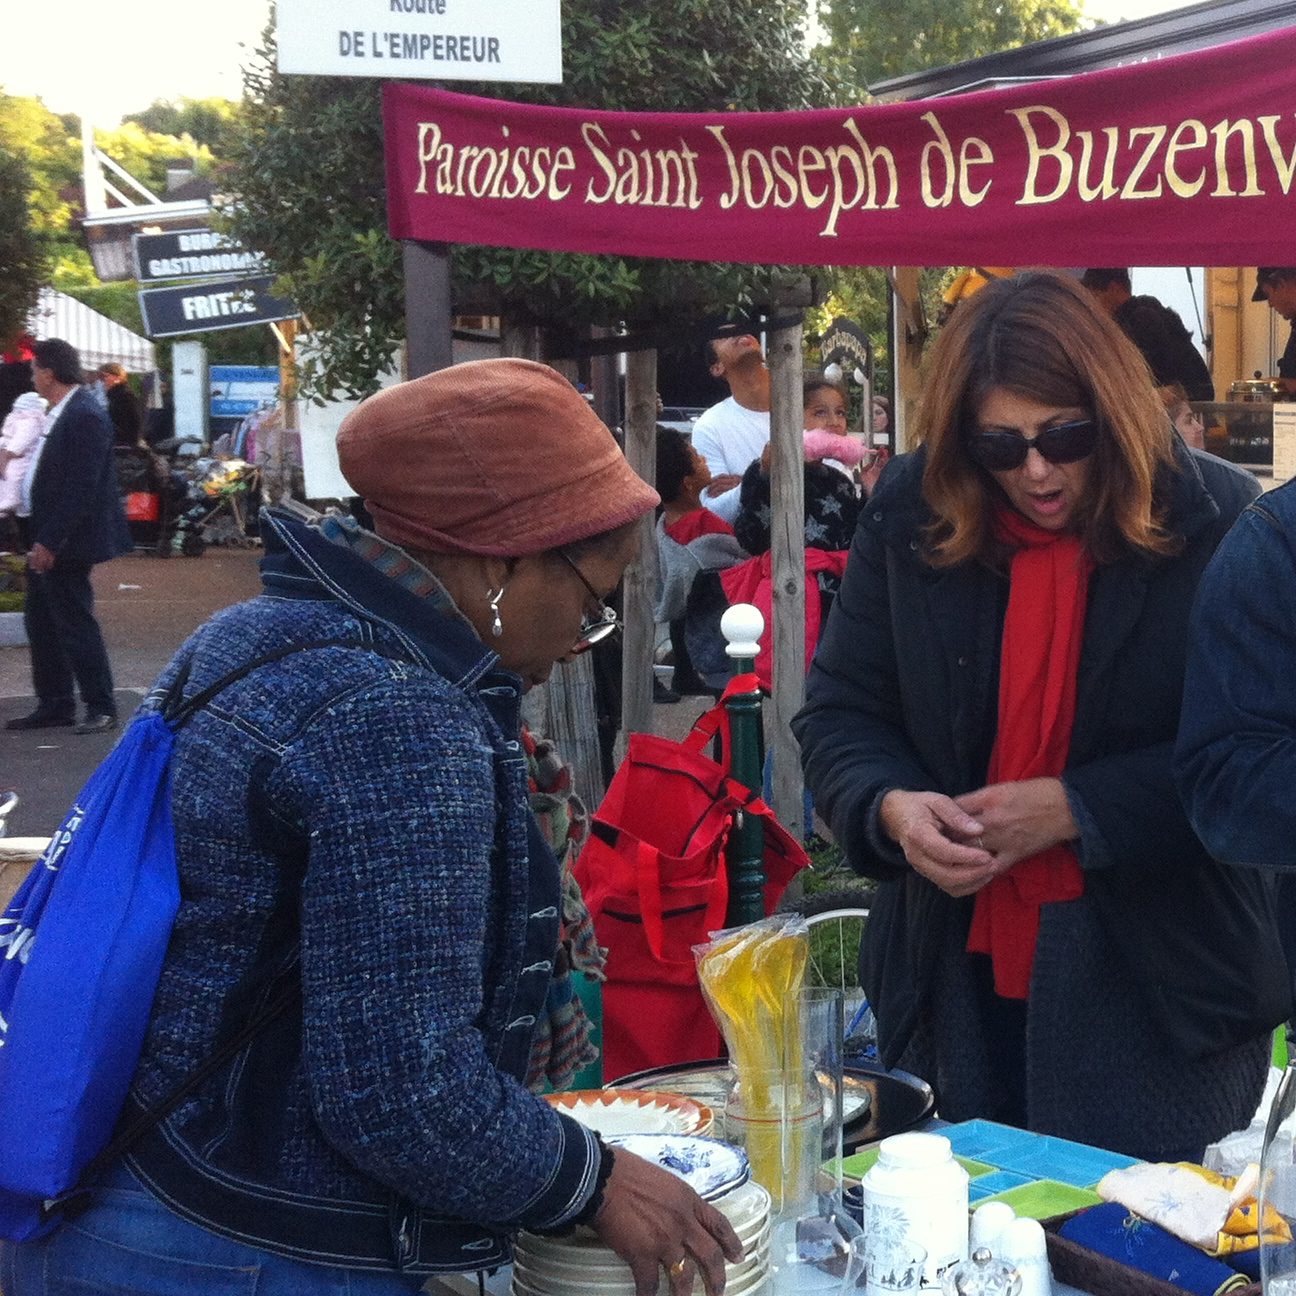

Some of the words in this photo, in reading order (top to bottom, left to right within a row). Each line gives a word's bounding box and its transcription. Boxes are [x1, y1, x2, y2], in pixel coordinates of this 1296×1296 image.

[339, 30, 365, 58] DE
[371, 33, 501, 63] L'EMPEREUR
[414, 122, 576, 200] Paroisse
[581, 121, 704, 209] Saint
[704, 117, 900, 238] Joseph
[920, 112, 994, 208] de
